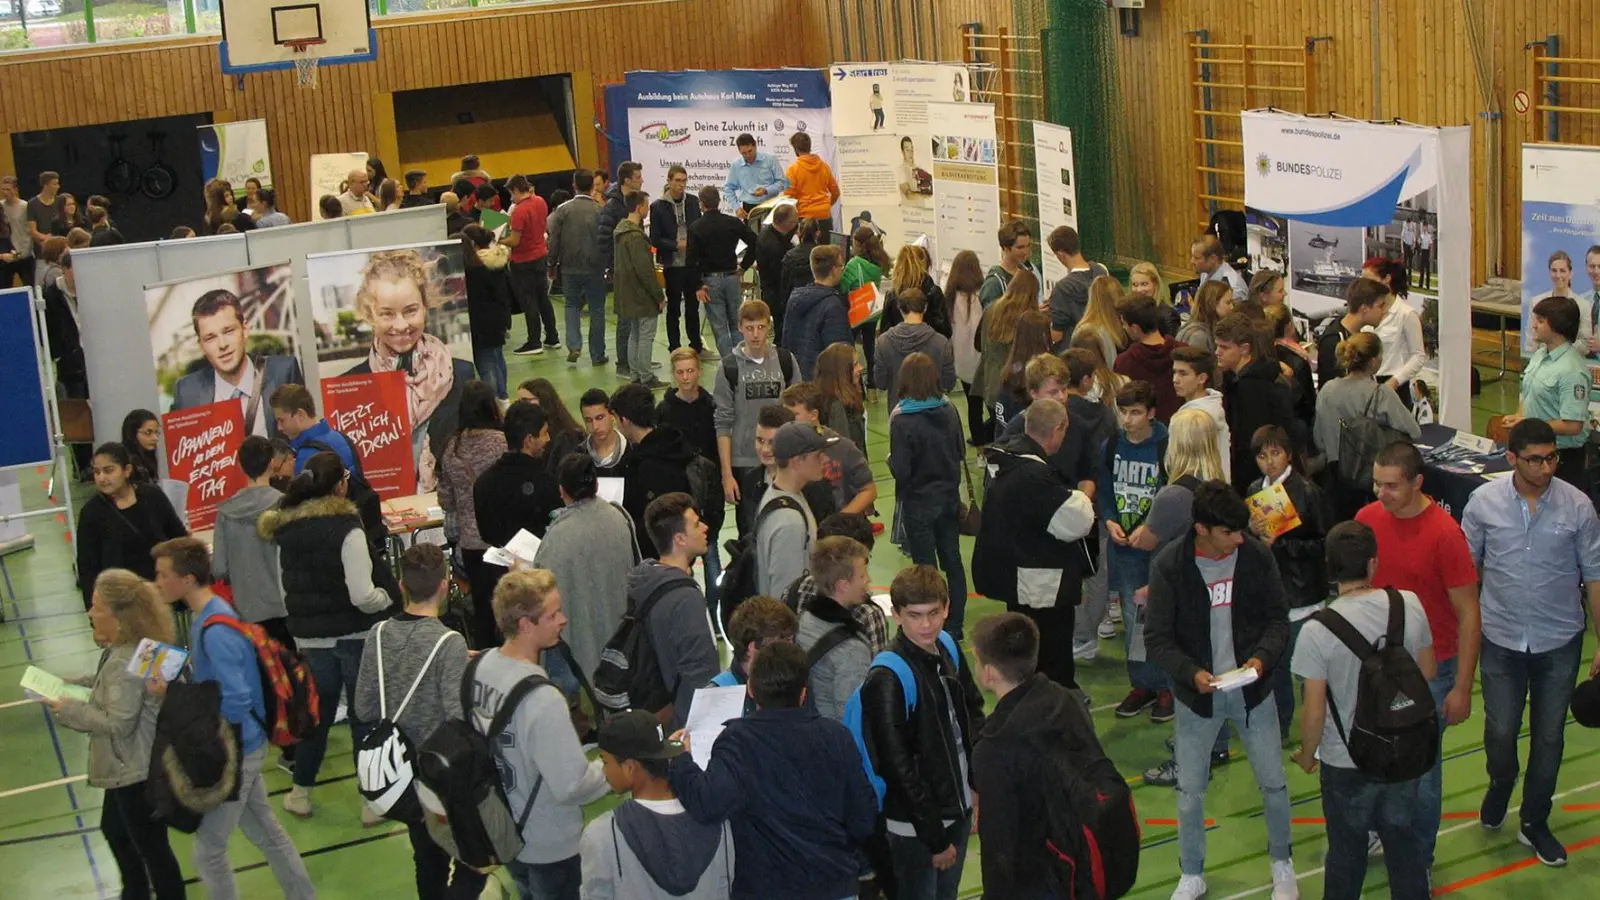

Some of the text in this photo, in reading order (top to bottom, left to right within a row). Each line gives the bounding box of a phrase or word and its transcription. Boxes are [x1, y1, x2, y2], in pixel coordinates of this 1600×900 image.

[637, 92, 756, 102] Ausbildung beim Autohaus Karl Moser
[694, 121, 768, 131] Deine Zukunft ist
[1281, 128, 1341, 141] www.bundespolizei.de
[698, 138, 727, 147] unsere
[1276, 161, 1343, 181] BUNDESPOLIZEI
[747, 383, 779, 398] STER
[330, 401, 375, 431] JETZT
[172, 419, 234, 466] SPANNEND
[358, 415, 405, 458] DRAN!
[205, 441, 226, 462] DEM
[189, 450, 238, 484] ERSTEN
[1113, 459, 1159, 485] PARTY
[197, 475, 227, 501] TAG
[1390, 699, 1415, 711] adidas
